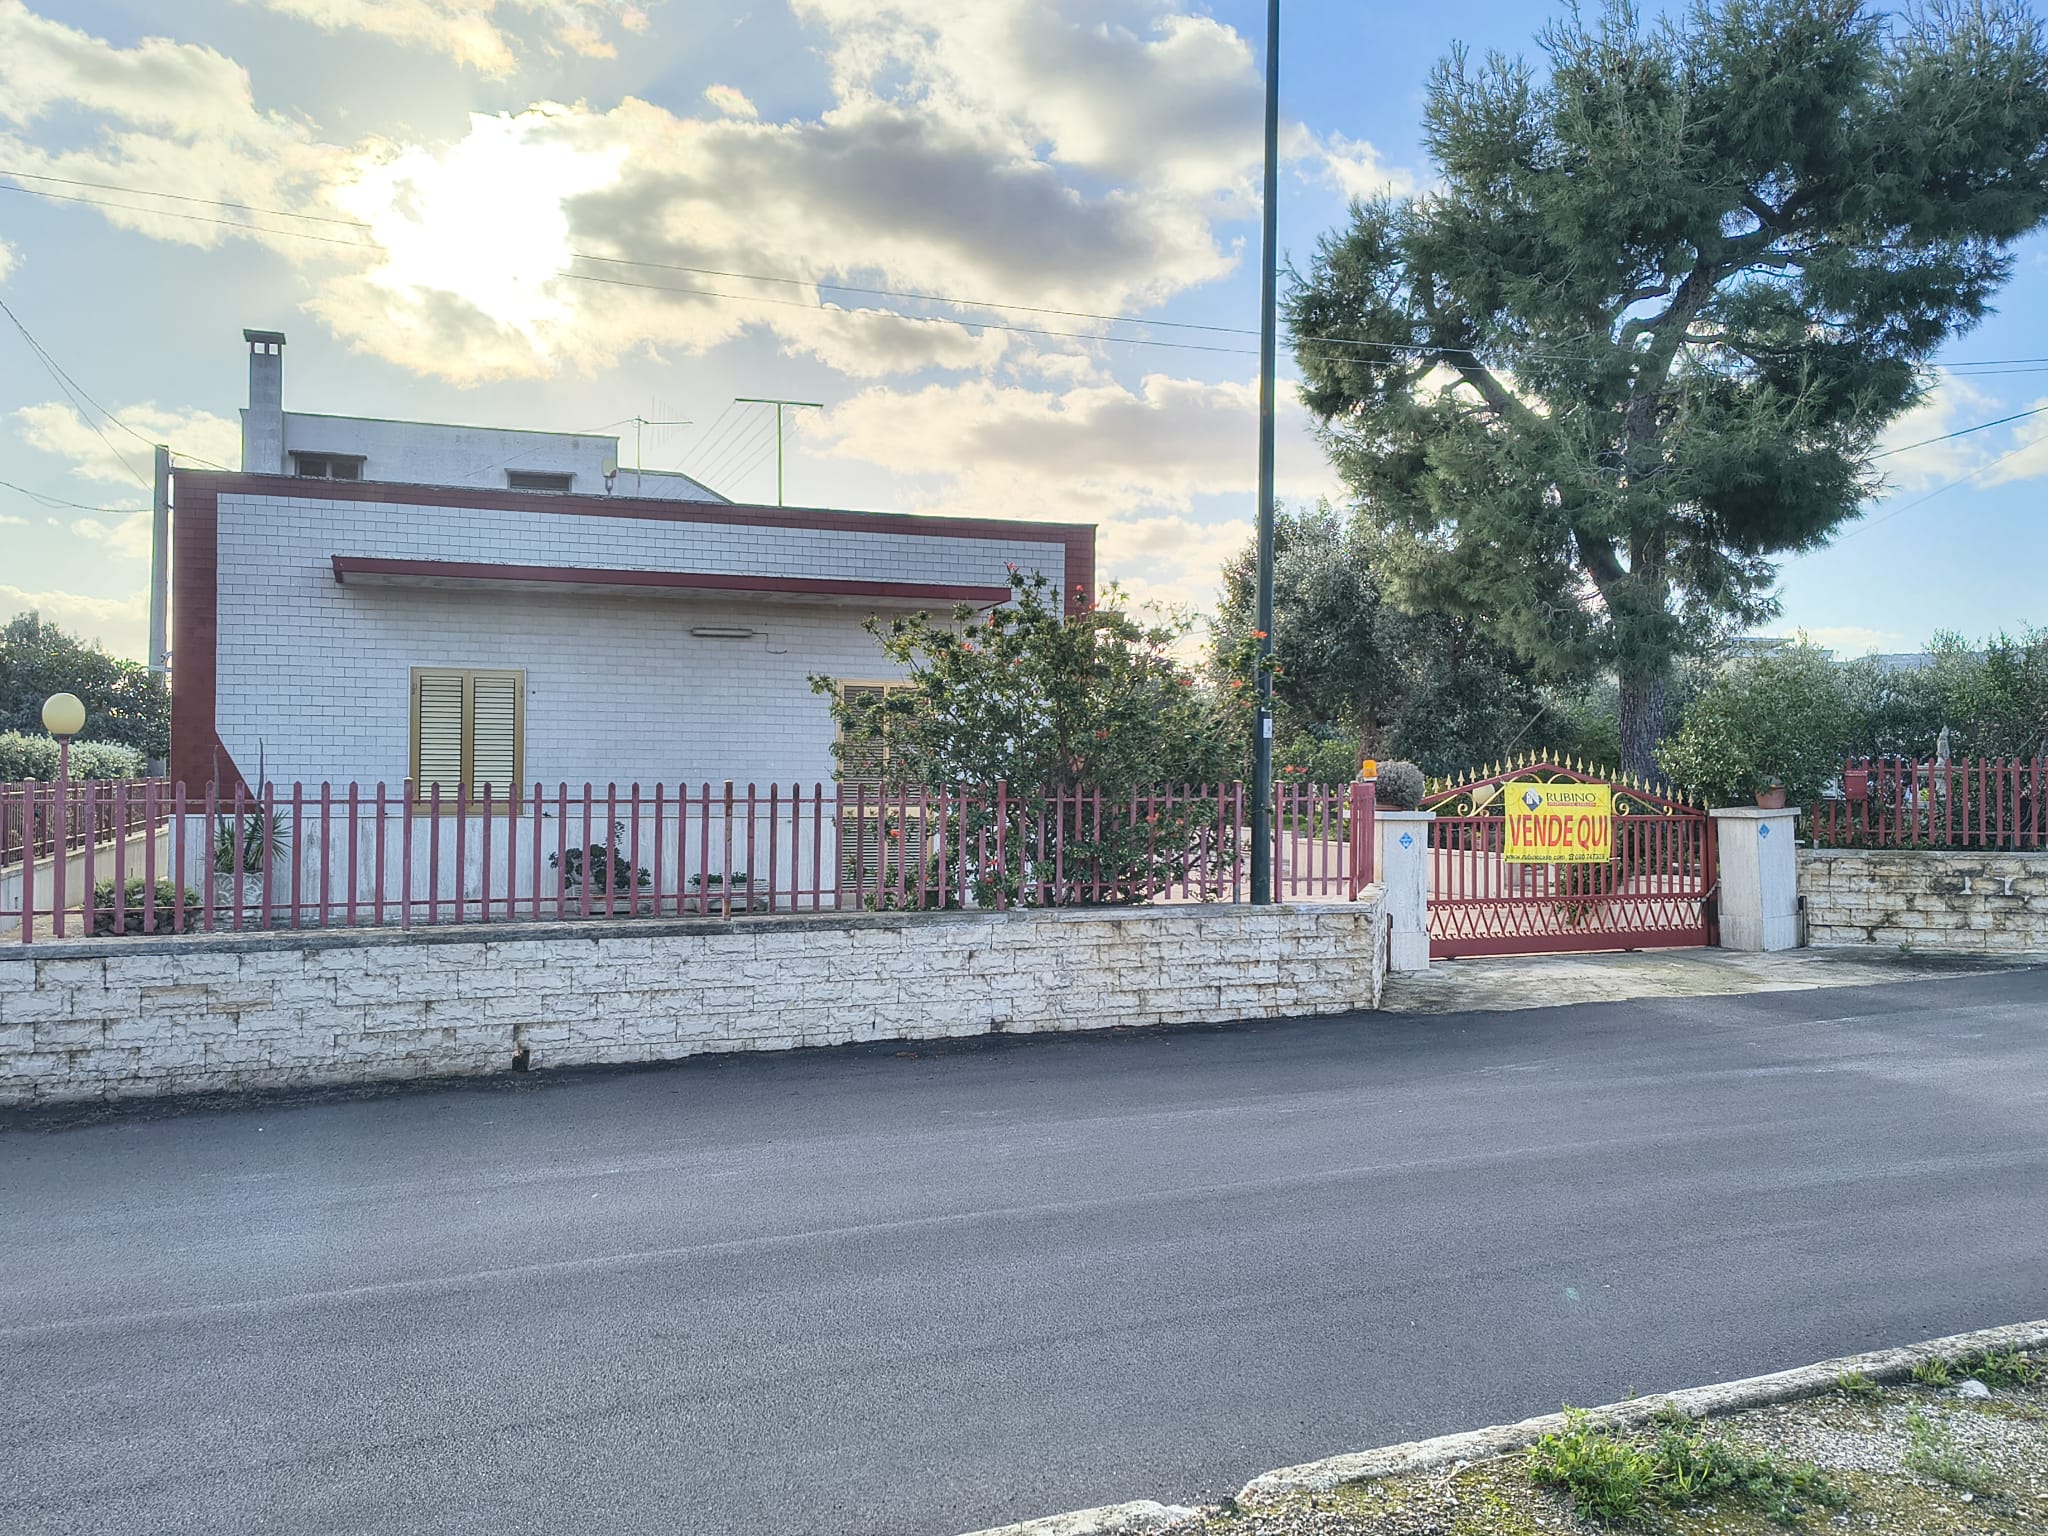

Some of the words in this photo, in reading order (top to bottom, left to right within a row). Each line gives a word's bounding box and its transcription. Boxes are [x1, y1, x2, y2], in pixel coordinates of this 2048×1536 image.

[1546, 792, 1596, 802] RUBINO
[1509, 814, 1573, 847] VENDE
[1577, 814, 1608, 851] QUI
